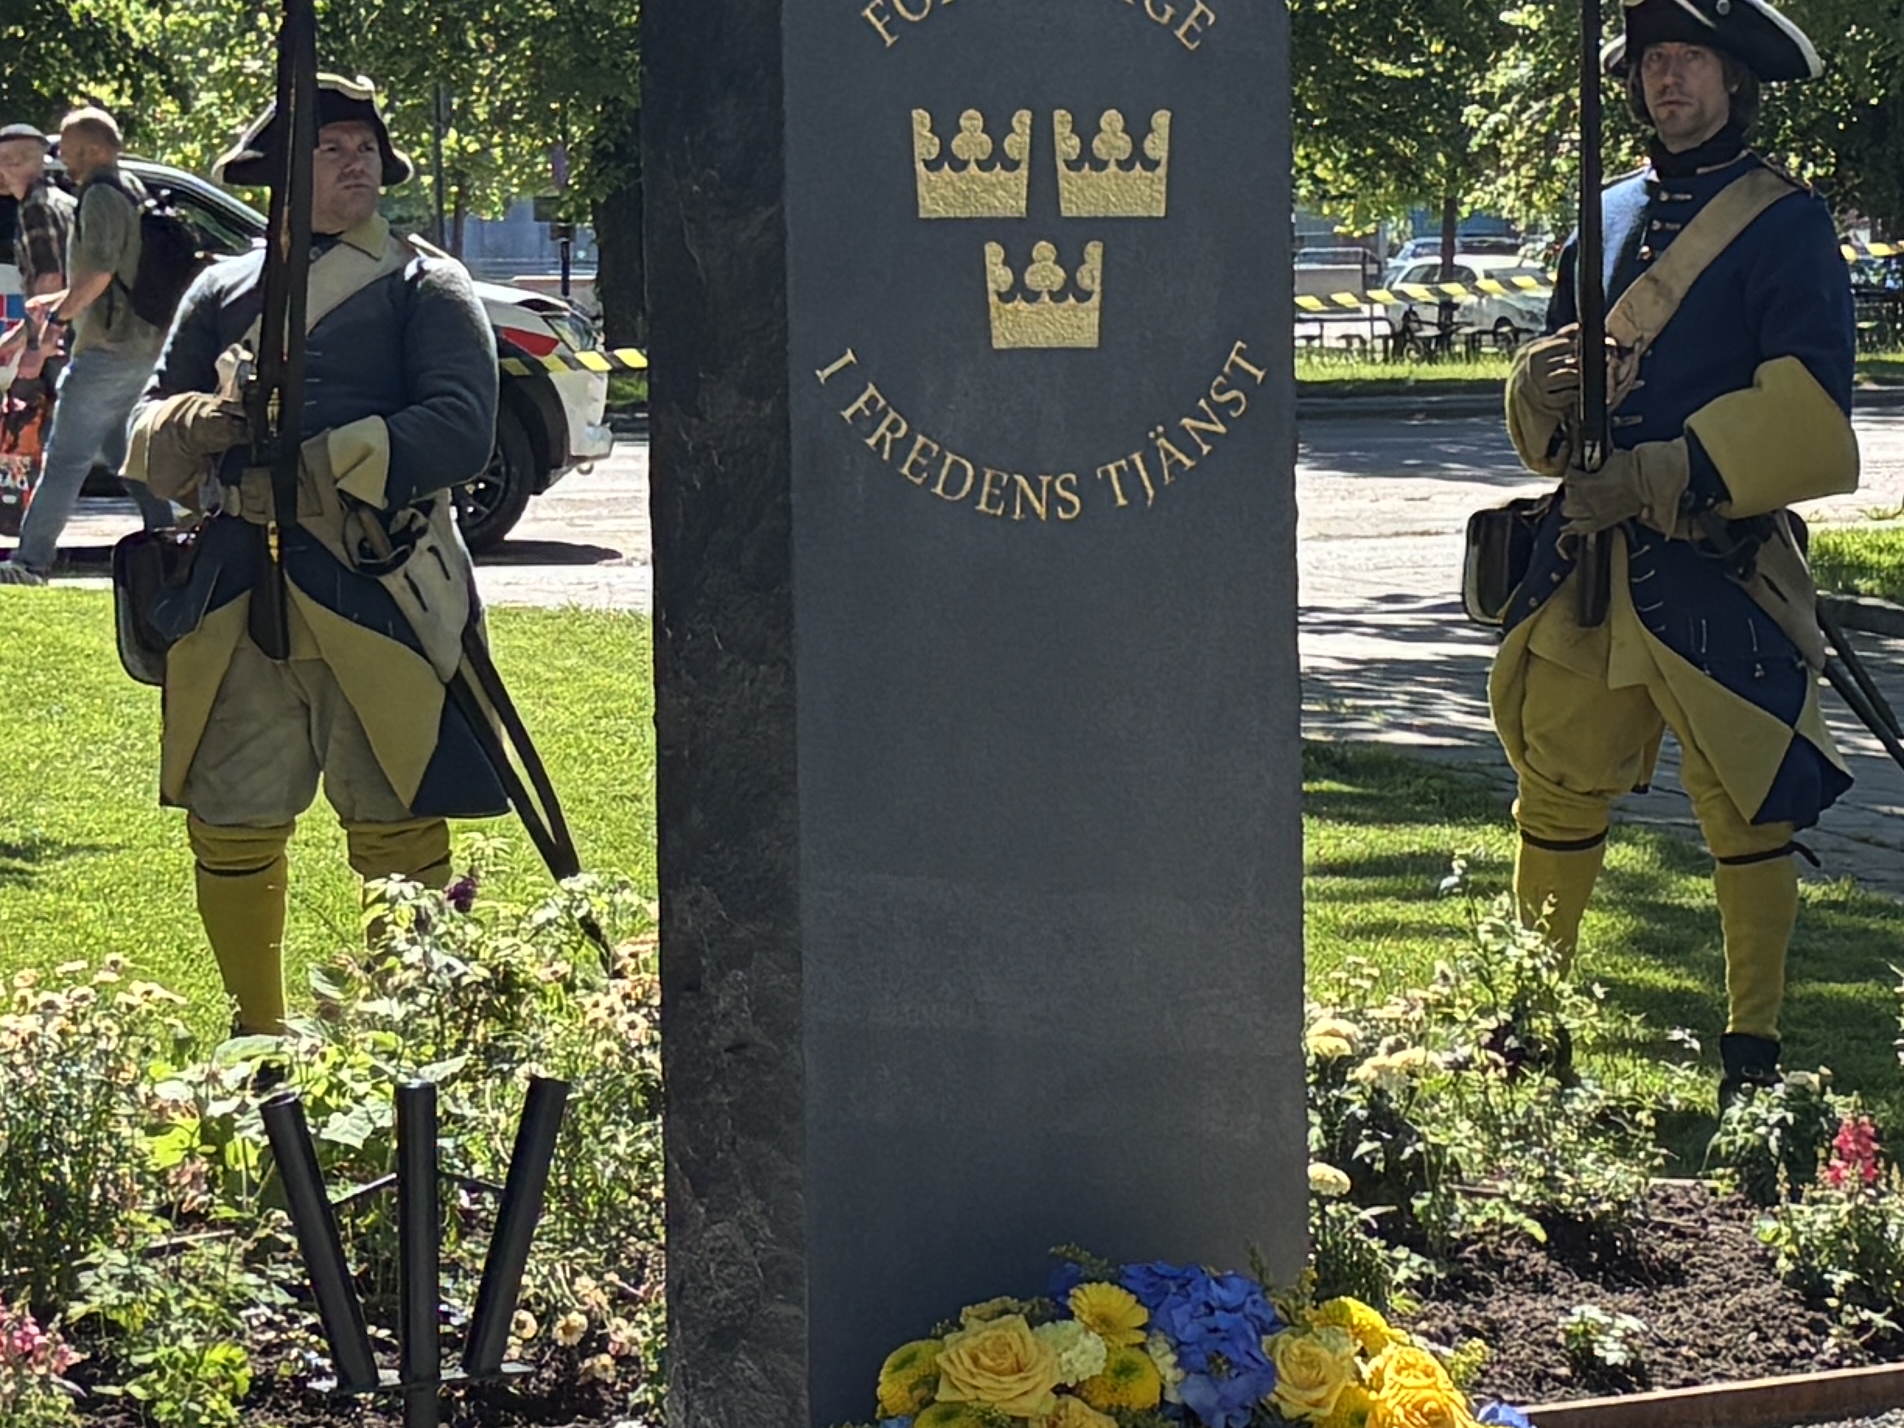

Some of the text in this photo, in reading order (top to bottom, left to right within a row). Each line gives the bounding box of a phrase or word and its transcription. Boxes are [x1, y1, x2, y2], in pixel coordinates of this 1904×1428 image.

[815, 340, 1268, 522] I FREDENS TJÄNST
